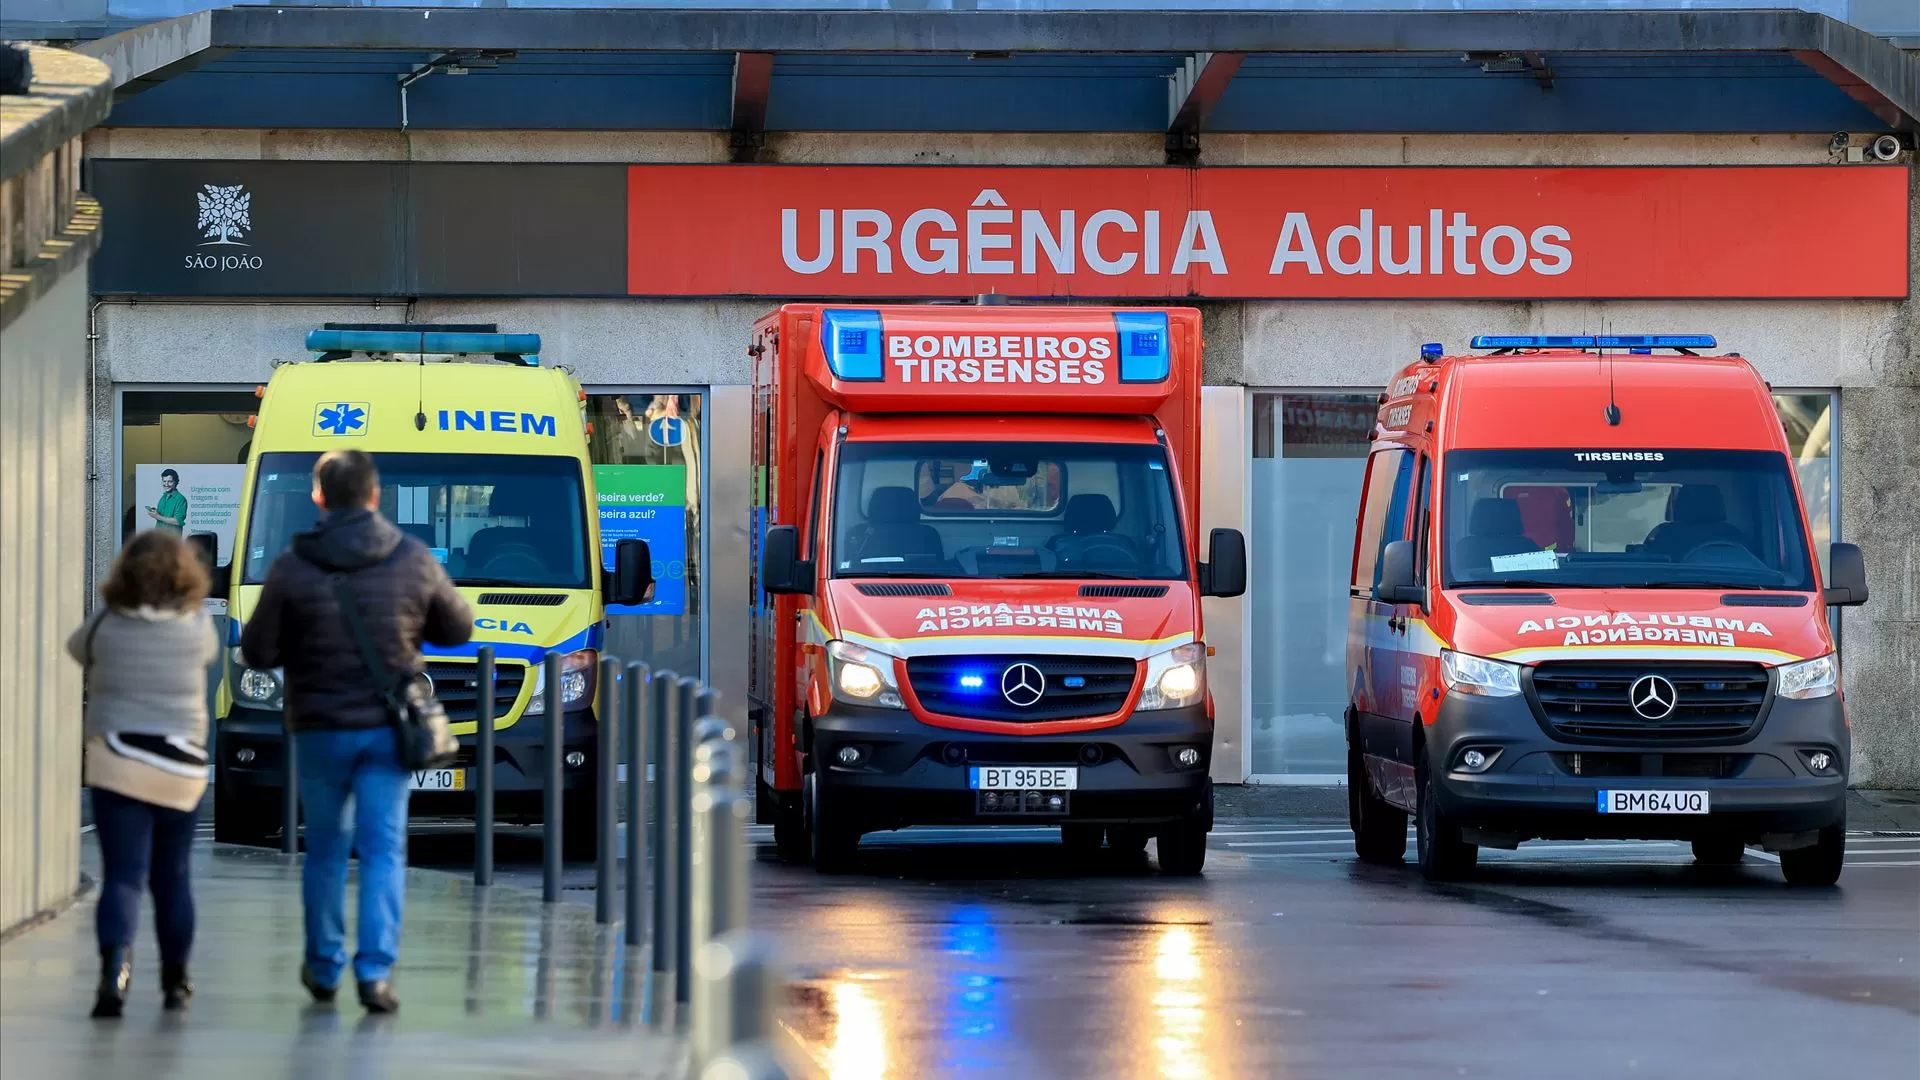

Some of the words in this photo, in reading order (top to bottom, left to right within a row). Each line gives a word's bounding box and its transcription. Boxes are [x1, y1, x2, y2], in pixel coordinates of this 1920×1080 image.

[781, 189, 1228, 275] URGÊNCIA
[1268, 208, 1572, 275] Adultos
[184, 253, 217, 269] SÃO
[221, 253, 263, 272] JOÃO
[889, 335, 1112, 359] BOMBEIROS
[895, 359, 1105, 384] TIRSENSES
[438, 410, 556, 437] INEM
[1574, 452, 1664, 461] TIRSENSES
[629, 492, 664, 502] verde?
[629, 509, 656, 519] azul?
